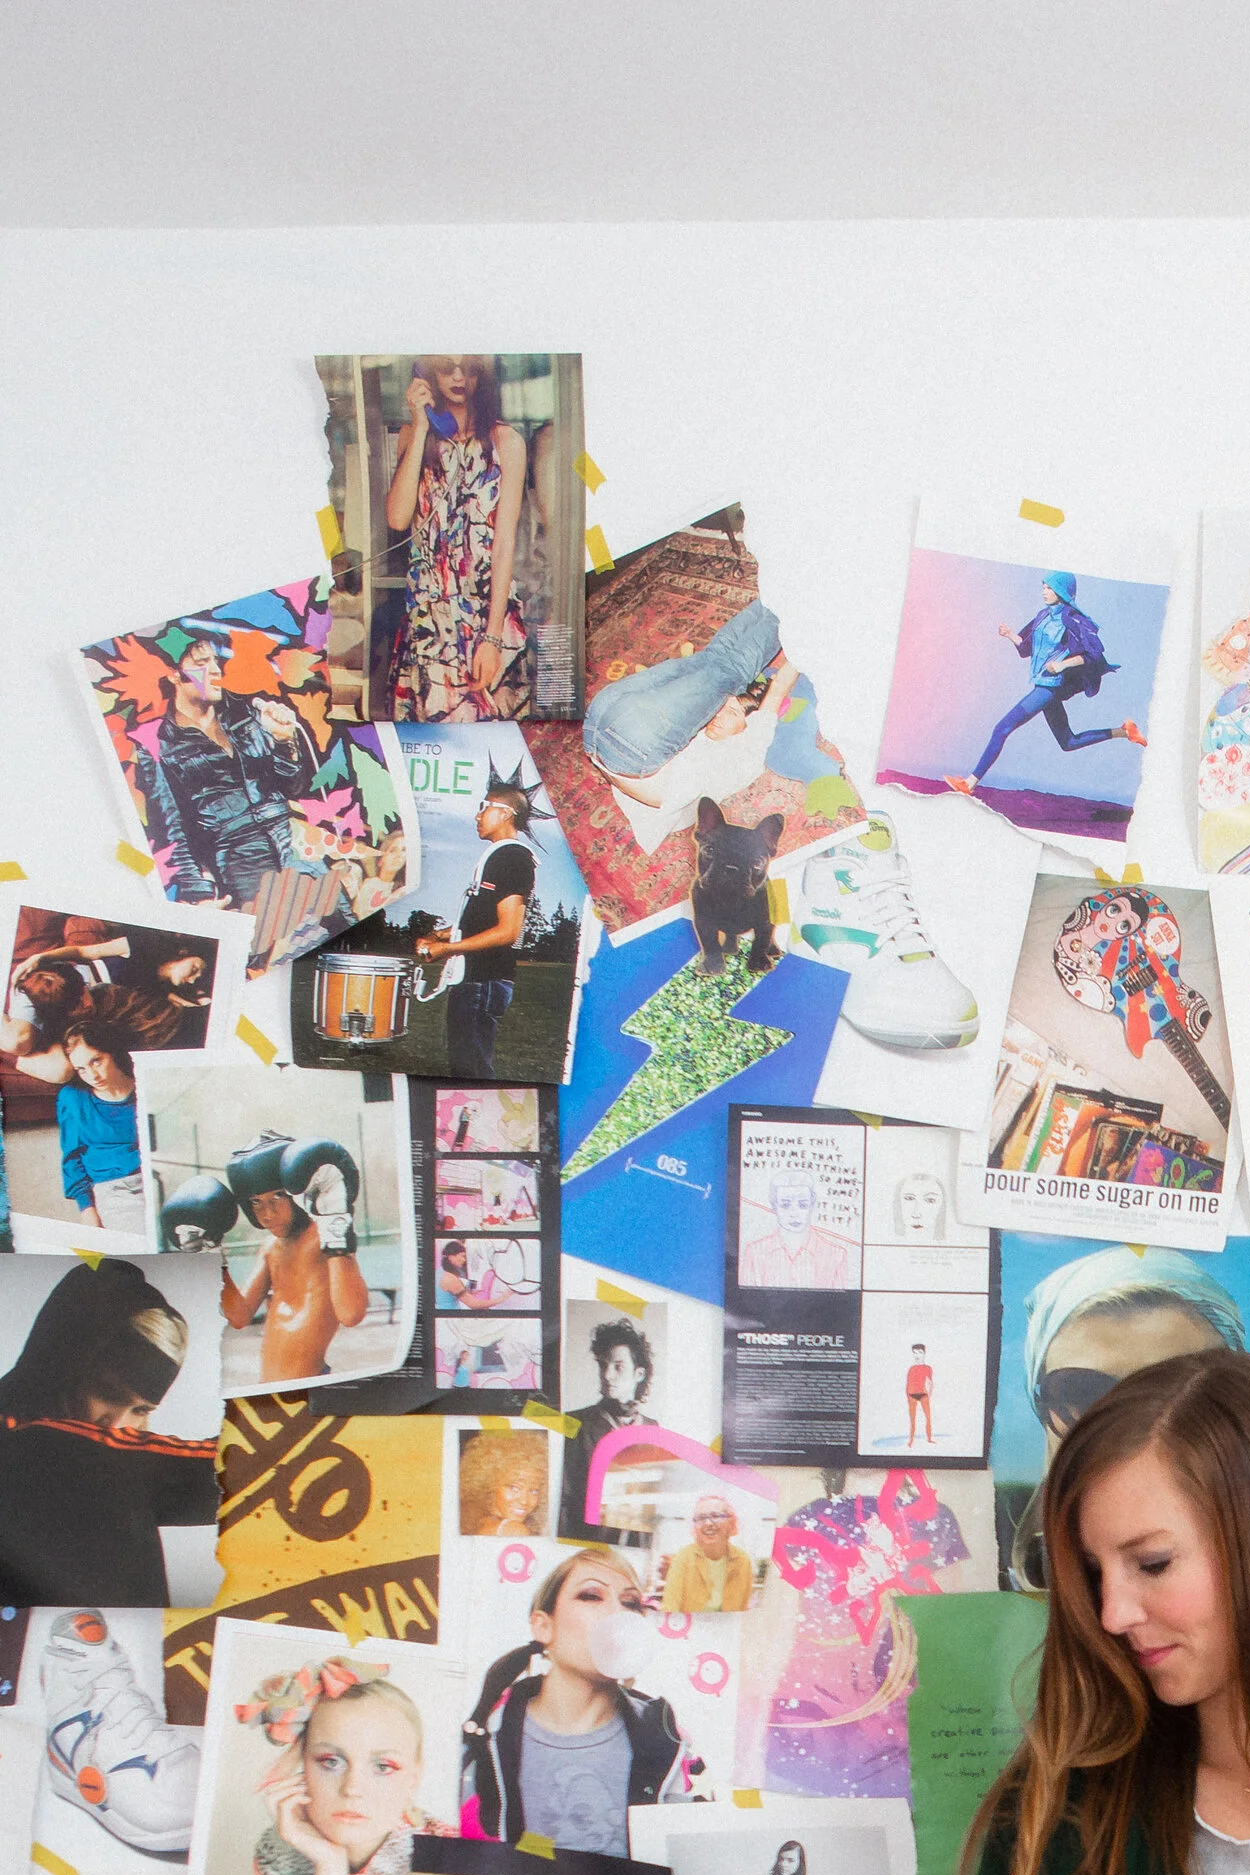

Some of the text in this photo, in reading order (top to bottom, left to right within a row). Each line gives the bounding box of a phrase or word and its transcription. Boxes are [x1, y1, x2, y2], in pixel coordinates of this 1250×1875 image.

[425, 744, 442, 755] TO
[746, 1136, 803, 1145] AWESOME
[746, 1148, 806, 1159] AWESOME
[656, 1153, 689, 1177] 085
[787, 1161, 857, 1176] EVERYTHING
[984, 1171, 1220, 1214] pour some sugar on me
[797, 1334, 845, 1347] PEOPLE
